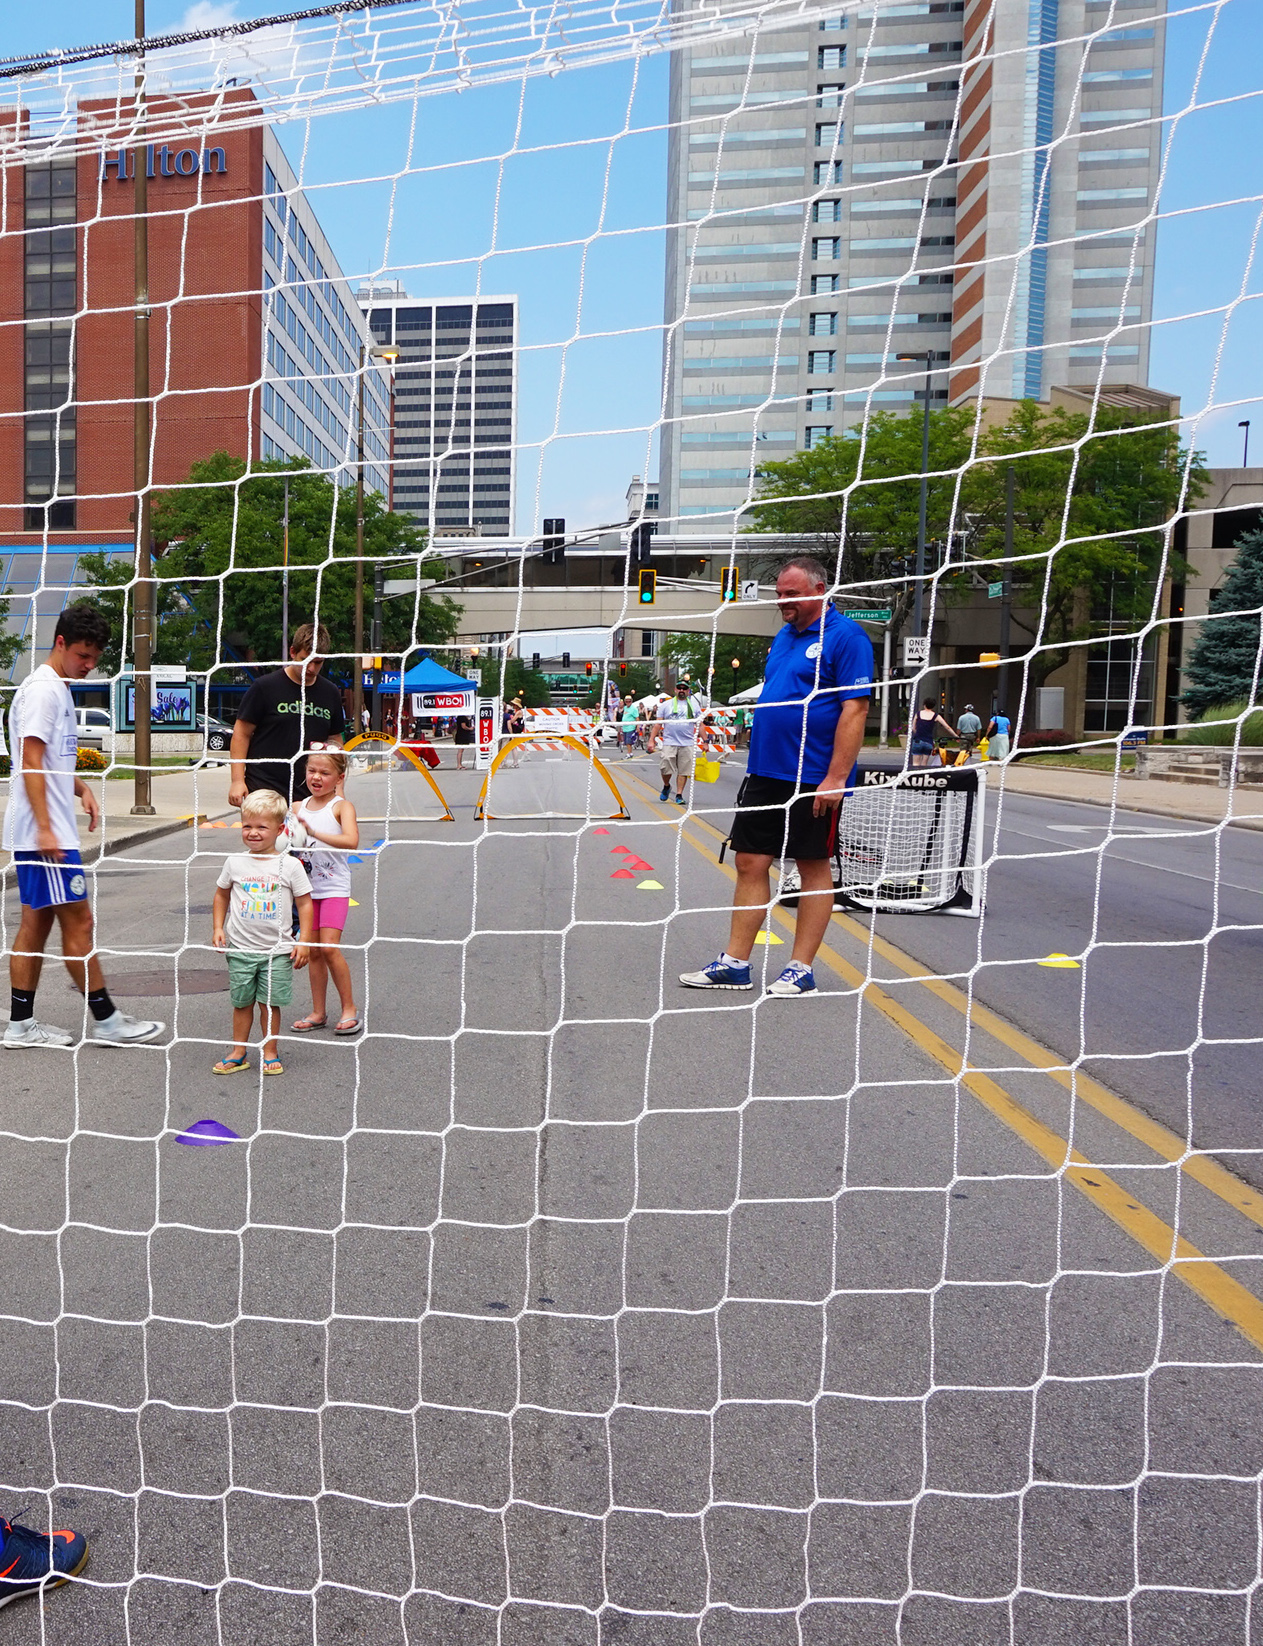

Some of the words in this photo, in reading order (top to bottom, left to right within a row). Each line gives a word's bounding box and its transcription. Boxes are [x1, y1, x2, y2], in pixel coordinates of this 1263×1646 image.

[908, 639, 925, 647] ONE
[908, 647, 926, 655] WAY
[363, 673, 400, 685] Hlto
[436, 697, 463, 706] WBOI
[277, 700, 331, 720] adidas
[258, 912, 277, 920] TIME
